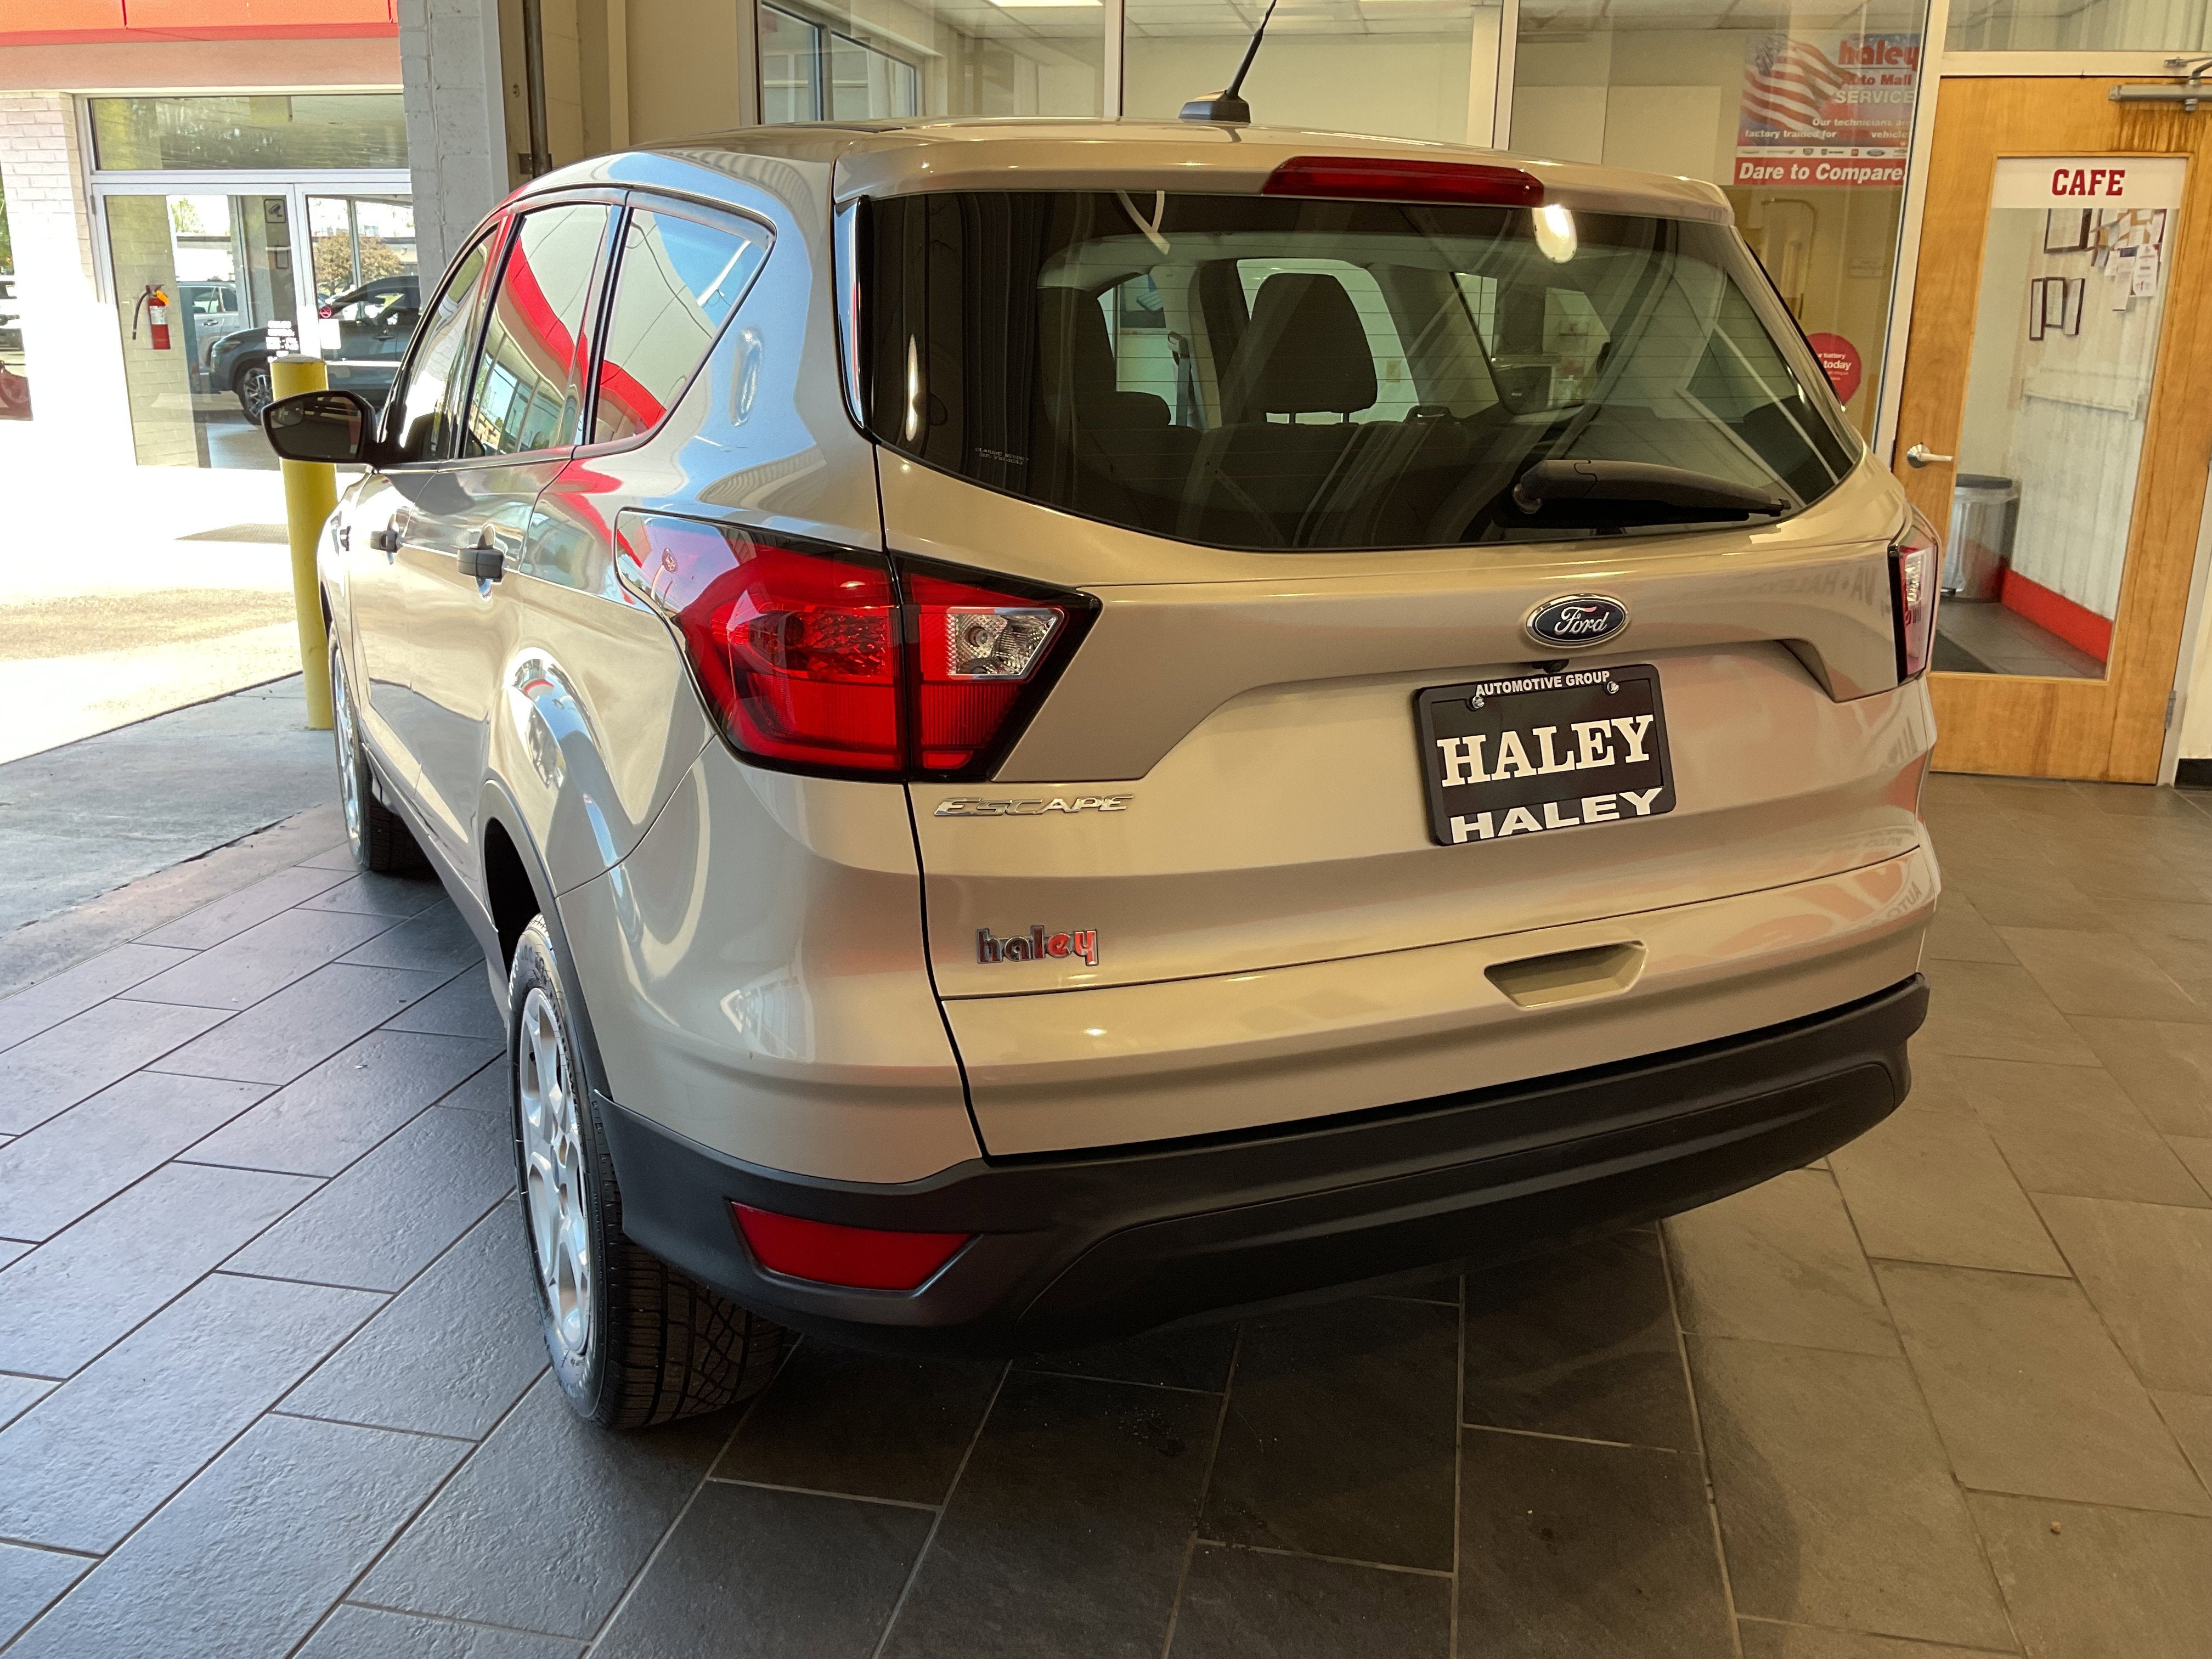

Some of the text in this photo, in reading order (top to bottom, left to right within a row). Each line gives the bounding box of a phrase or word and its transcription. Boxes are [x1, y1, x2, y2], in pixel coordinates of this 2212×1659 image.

[1838, 40, 1921, 71] haley
[1880, 74, 1912, 86] Mall
[1834, 89, 1915, 104] SERVICE
[1745, 129, 1781, 139] factory
[1821, 129, 1837, 139] for
[1812, 118, 1832, 126] Our
[1834, 118, 1892, 126] technicians
[1739, 162, 1905, 184] Dare to Compare
[2052, 168, 2126, 196] CAFE
[1823, 360, 1852, 371] today
[1554, 605, 1609, 635] Ford
[1475, 670, 1611, 697] AUTOMOTIVE GROUP
[1436, 714, 1654, 787] HALEY
[934, 794, 1134, 816] ESCAPE
[1448, 787, 1663, 844] HALEY
[975, 924, 1099, 966] haley
